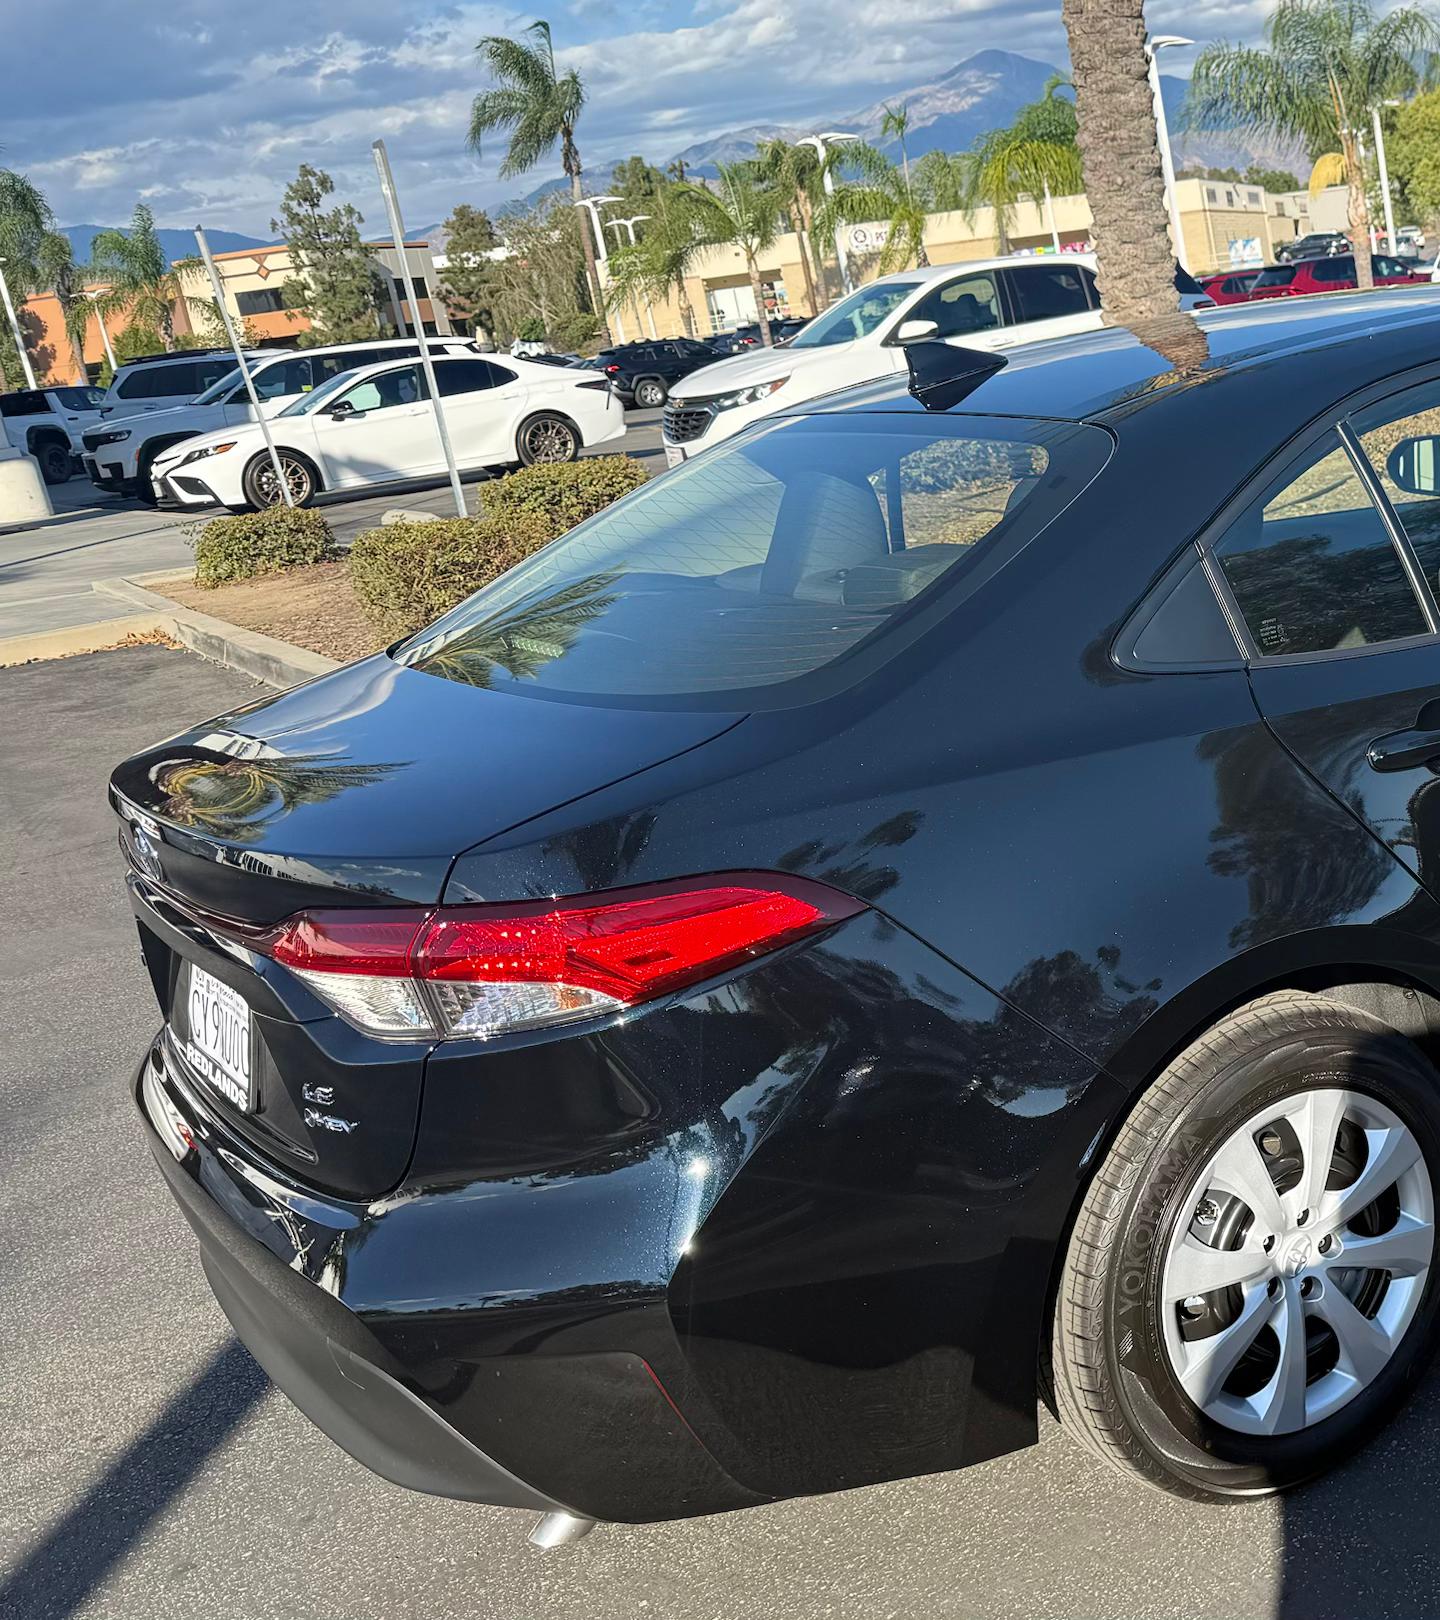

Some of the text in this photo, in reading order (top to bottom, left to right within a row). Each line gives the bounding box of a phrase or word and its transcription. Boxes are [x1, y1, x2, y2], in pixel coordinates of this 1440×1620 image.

[186, 1041, 248, 1112] REDLANDS
[302, 1081, 335, 1105] LE
[1119, 1132, 1203, 1316] YOKOHAMA
